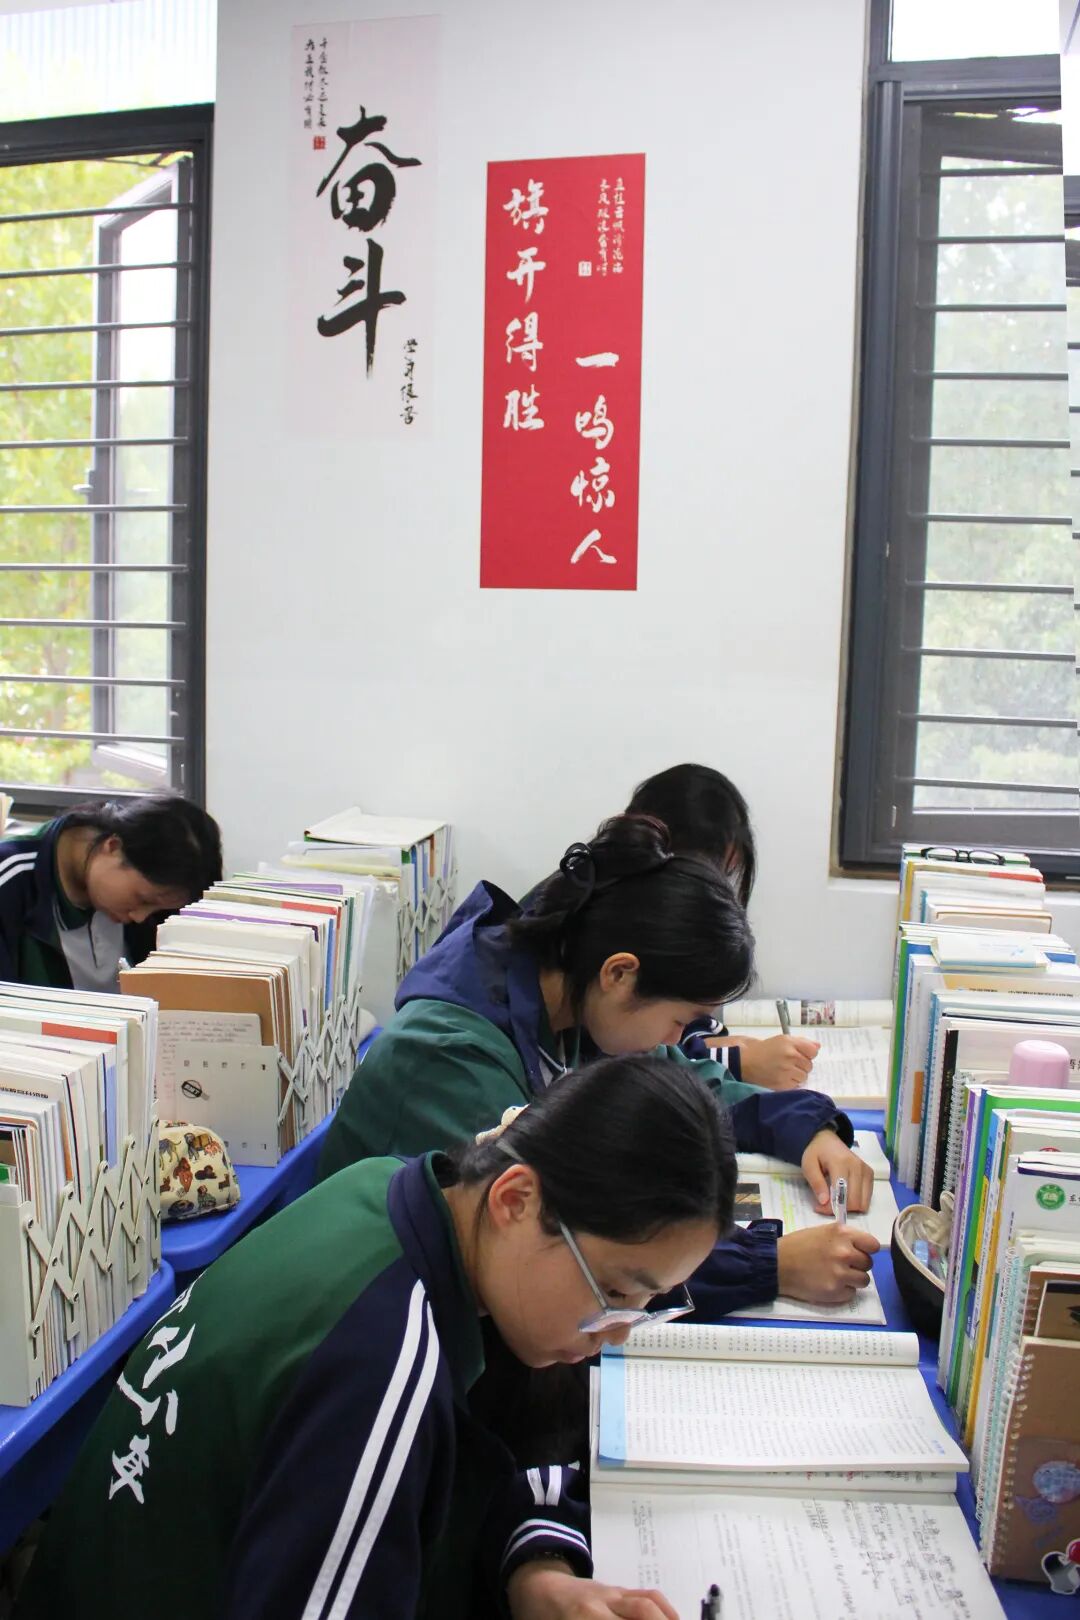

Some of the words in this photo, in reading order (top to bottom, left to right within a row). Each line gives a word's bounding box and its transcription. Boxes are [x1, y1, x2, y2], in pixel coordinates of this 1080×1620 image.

[316, 104, 423, 379] 奋斗
[502, 178, 550, 432] 旗开得胜
[570, 351, 621, 566] 一鸣惊人
